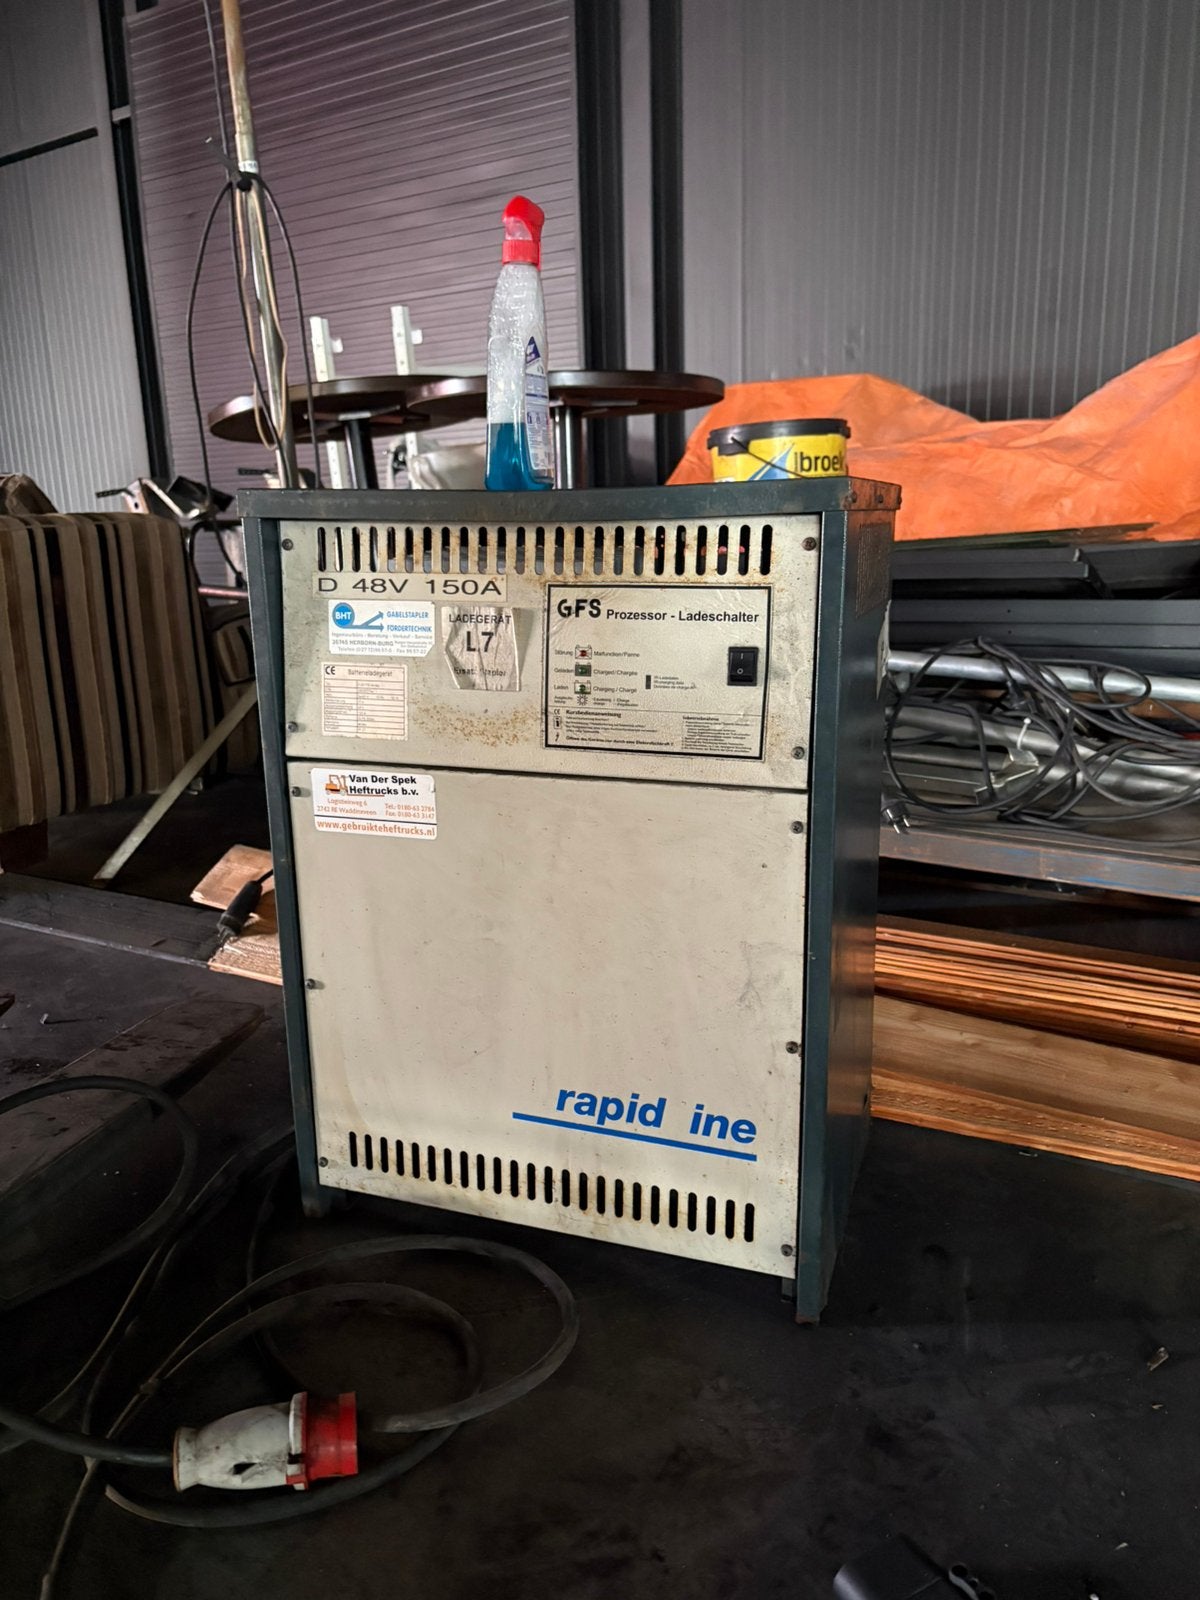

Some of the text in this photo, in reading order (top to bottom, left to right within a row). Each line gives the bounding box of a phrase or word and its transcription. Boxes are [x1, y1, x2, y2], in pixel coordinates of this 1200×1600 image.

[318, 577, 502, 595] D 48V 150A
[335, 611, 352, 620] BHT
[557, 598, 602, 618] GFS
[606, 609, 667, 620] Prozessor
[678, 611, 760, 622] Ladeschalter
[349, 774, 417, 785] Van Der Spek
[349, 786, 419, 795] Heftrucks b.v.
[317, 821, 435, 836] www.gebruikteheftrucks.nl
[556, 1089, 667, 1128] rapid
